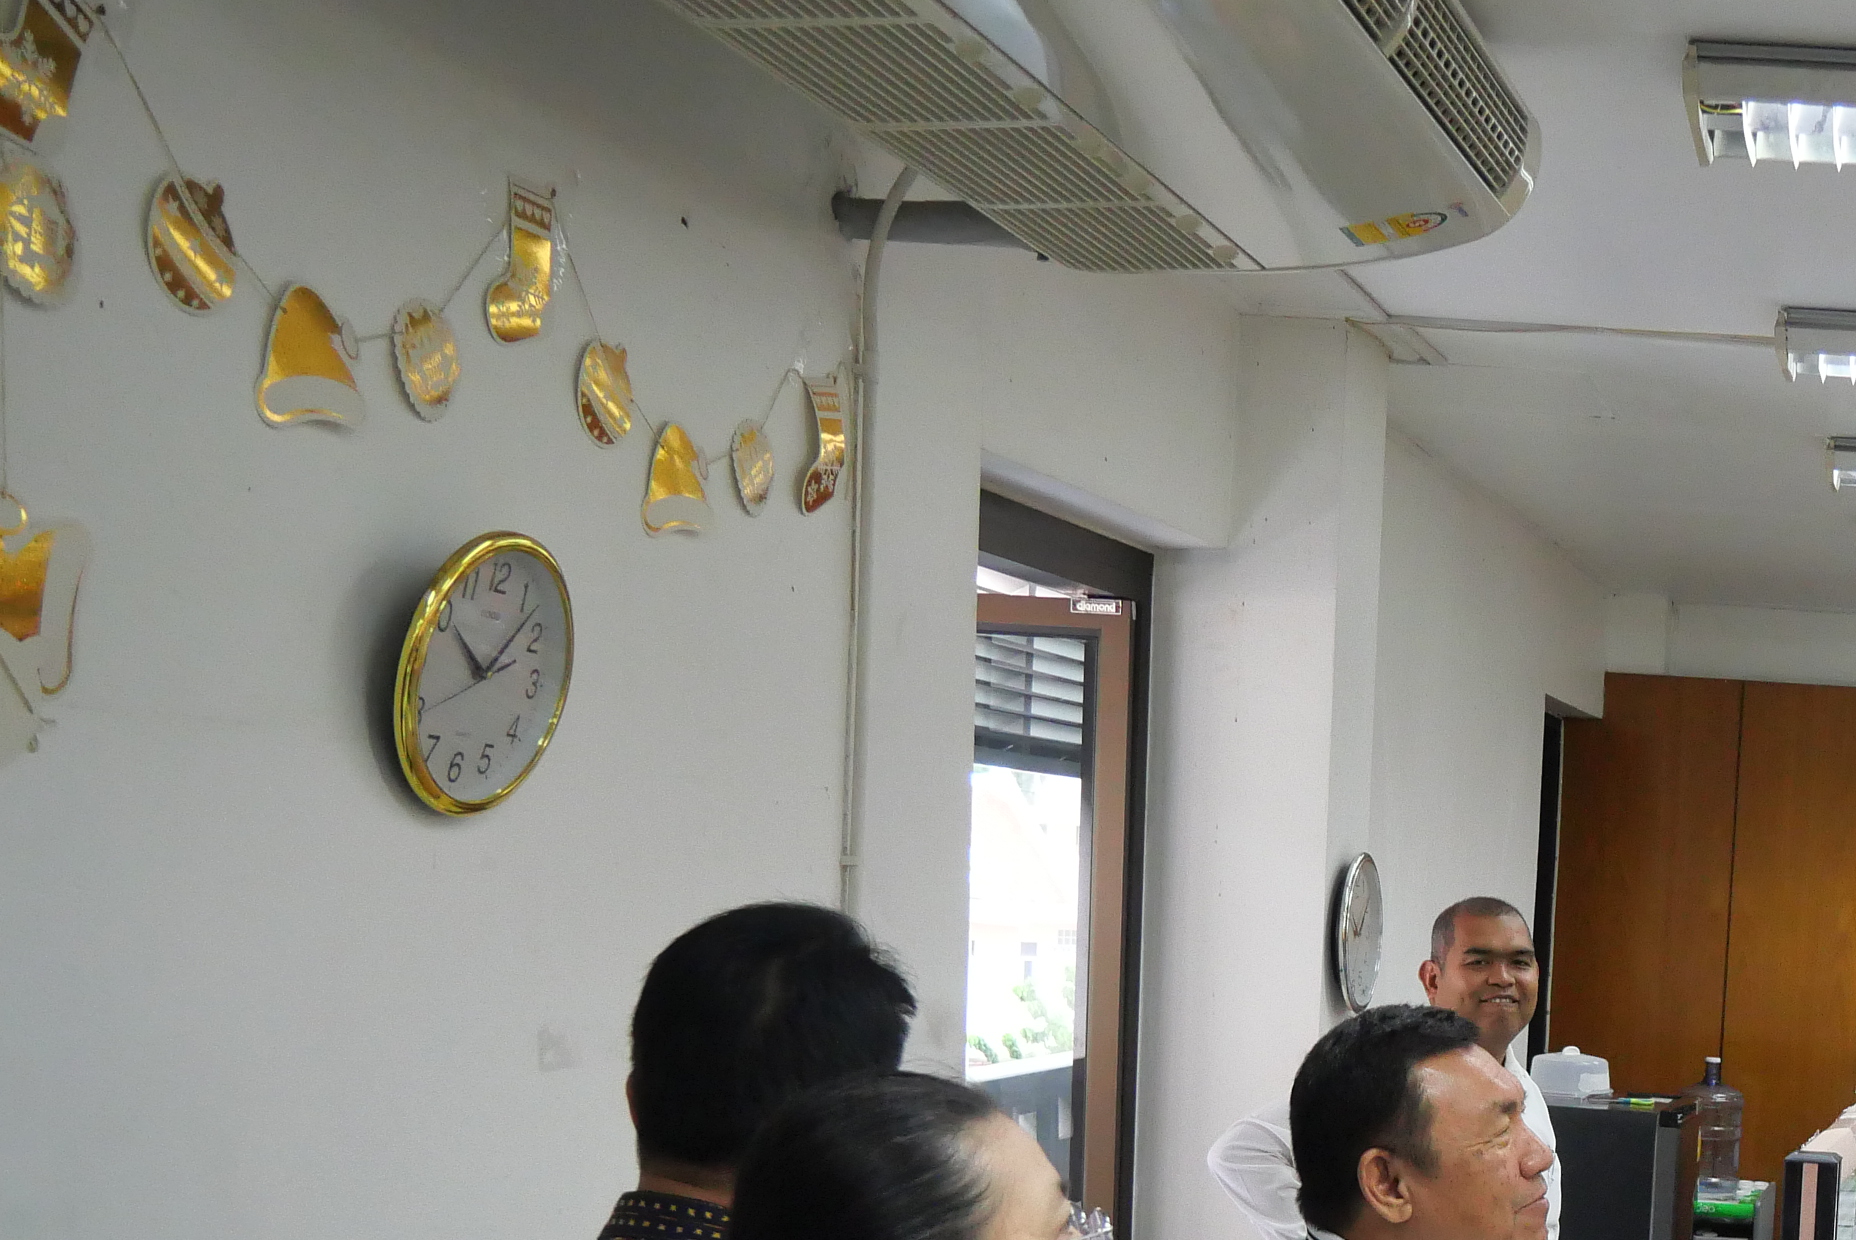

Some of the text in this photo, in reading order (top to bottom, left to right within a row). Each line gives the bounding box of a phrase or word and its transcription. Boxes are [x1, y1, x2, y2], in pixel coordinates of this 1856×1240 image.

[489, 562, 512, 595] 12
[519, 582, 529, 613] 1
[1076, 600, 1116, 612] diamond
[526, 622, 542, 654] 2
[525, 668, 540, 700] 3
[506, 714, 519, 745] 4
[424, 733, 441, 763] 7
[477, 743, 494, 774] 5
[447, 751, 464, 783] 6
